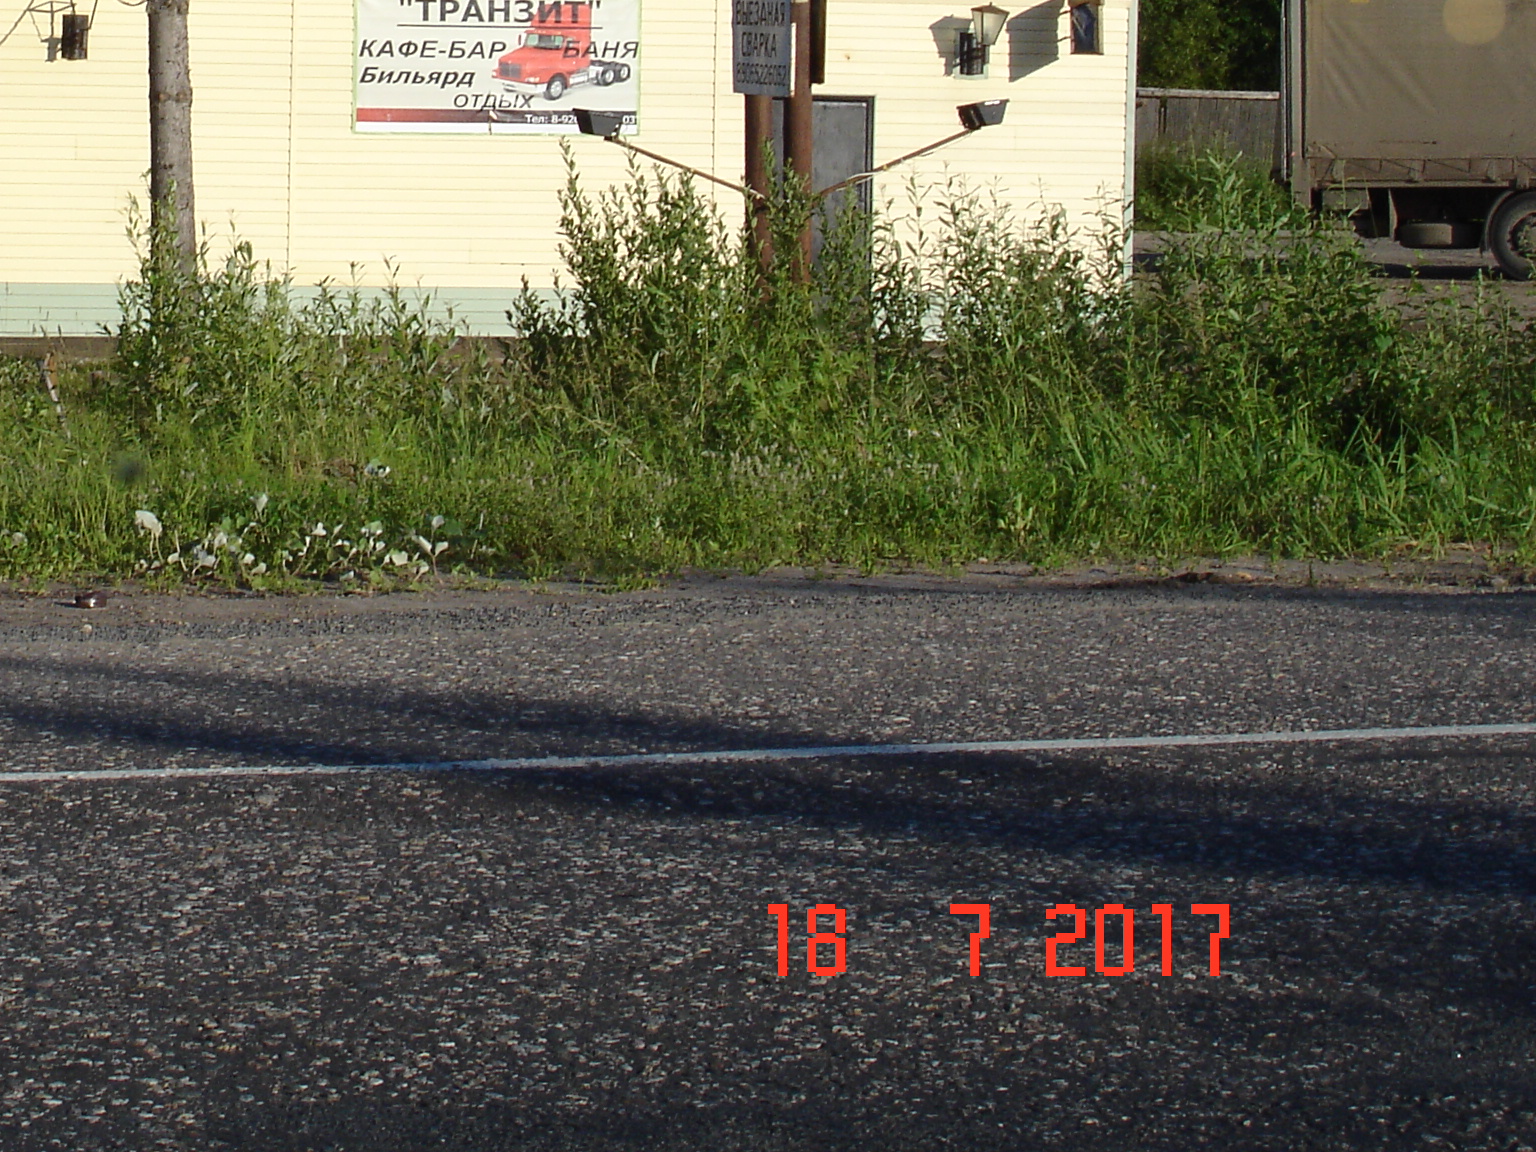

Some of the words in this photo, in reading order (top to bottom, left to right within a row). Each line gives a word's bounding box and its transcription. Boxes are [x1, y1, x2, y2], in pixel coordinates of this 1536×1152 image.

[359, 39, 507, 60] КАФЕ-БАР
[563, 40, 639, 59] БАНЯ
[741, 30, 777, 58] СВАРКА
[359, 66, 476, 89] Бильярд
